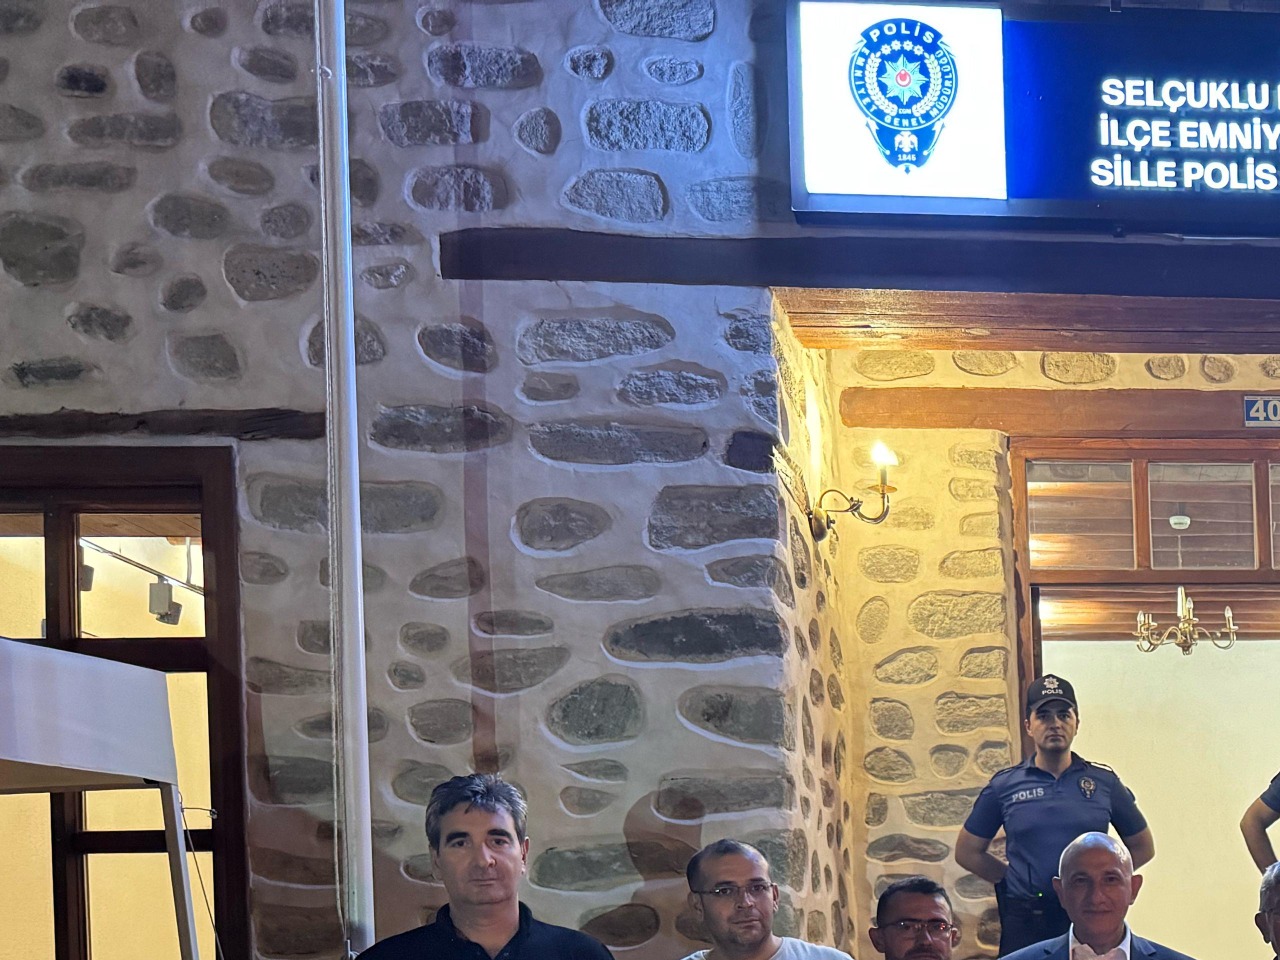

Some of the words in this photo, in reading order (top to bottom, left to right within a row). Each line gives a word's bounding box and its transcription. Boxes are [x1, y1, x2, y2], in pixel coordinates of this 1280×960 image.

[869, 22, 935, 44] POLİS
[1101, 78, 1269, 113] SELÇUKLU
[1100, 112, 1172, 152] İLÇE
[1090, 153, 1177, 188] SİLLE
[1183, 157, 1278, 189] POLİS
